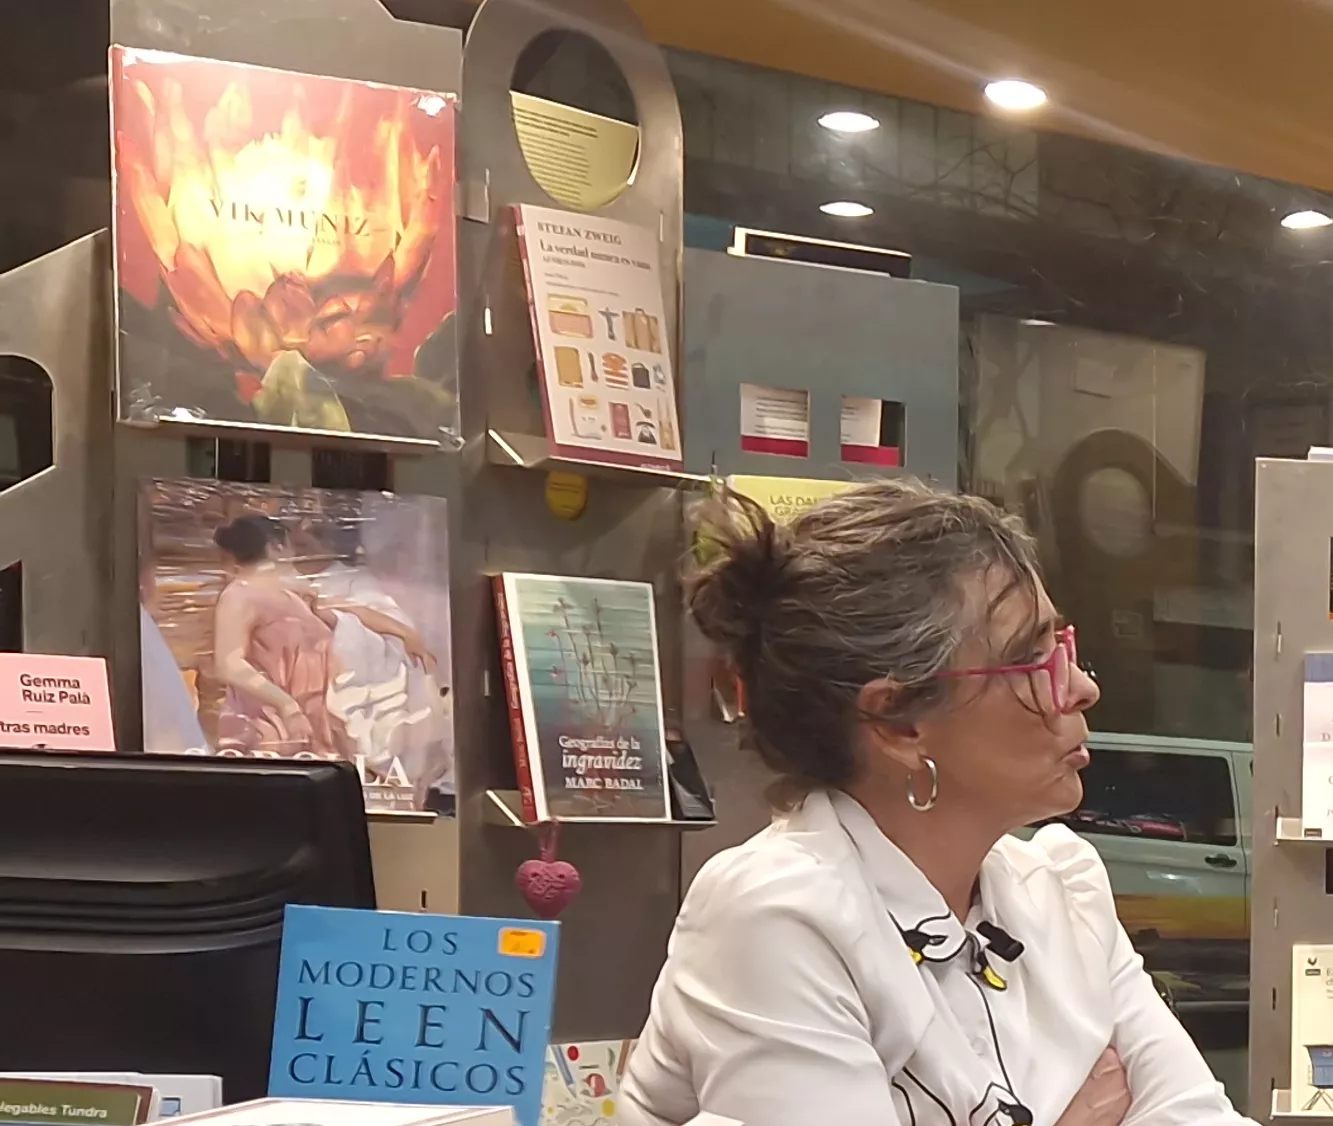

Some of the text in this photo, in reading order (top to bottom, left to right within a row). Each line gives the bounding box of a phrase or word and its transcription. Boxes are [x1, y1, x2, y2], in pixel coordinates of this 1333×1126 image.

[20, 673, 81, 689] Gemma
[22, 689, 91, 706] Ruiz Palà
[33, 721, 90, 737] madres
[617, 735, 630, 750] de
[631, 735, 641, 751] la
[562, 749, 643, 775] ingravidez
[565, 775, 644, 790] MARC BADAL
[381, 927, 458, 956] LOS
[298, 958, 537, 998] MODERNOS
[294, 995, 532, 1055] LEEN
[288, 1049, 528, 1096] CLÁSICOS
[61, 1103, 108, 1120] Tundra
